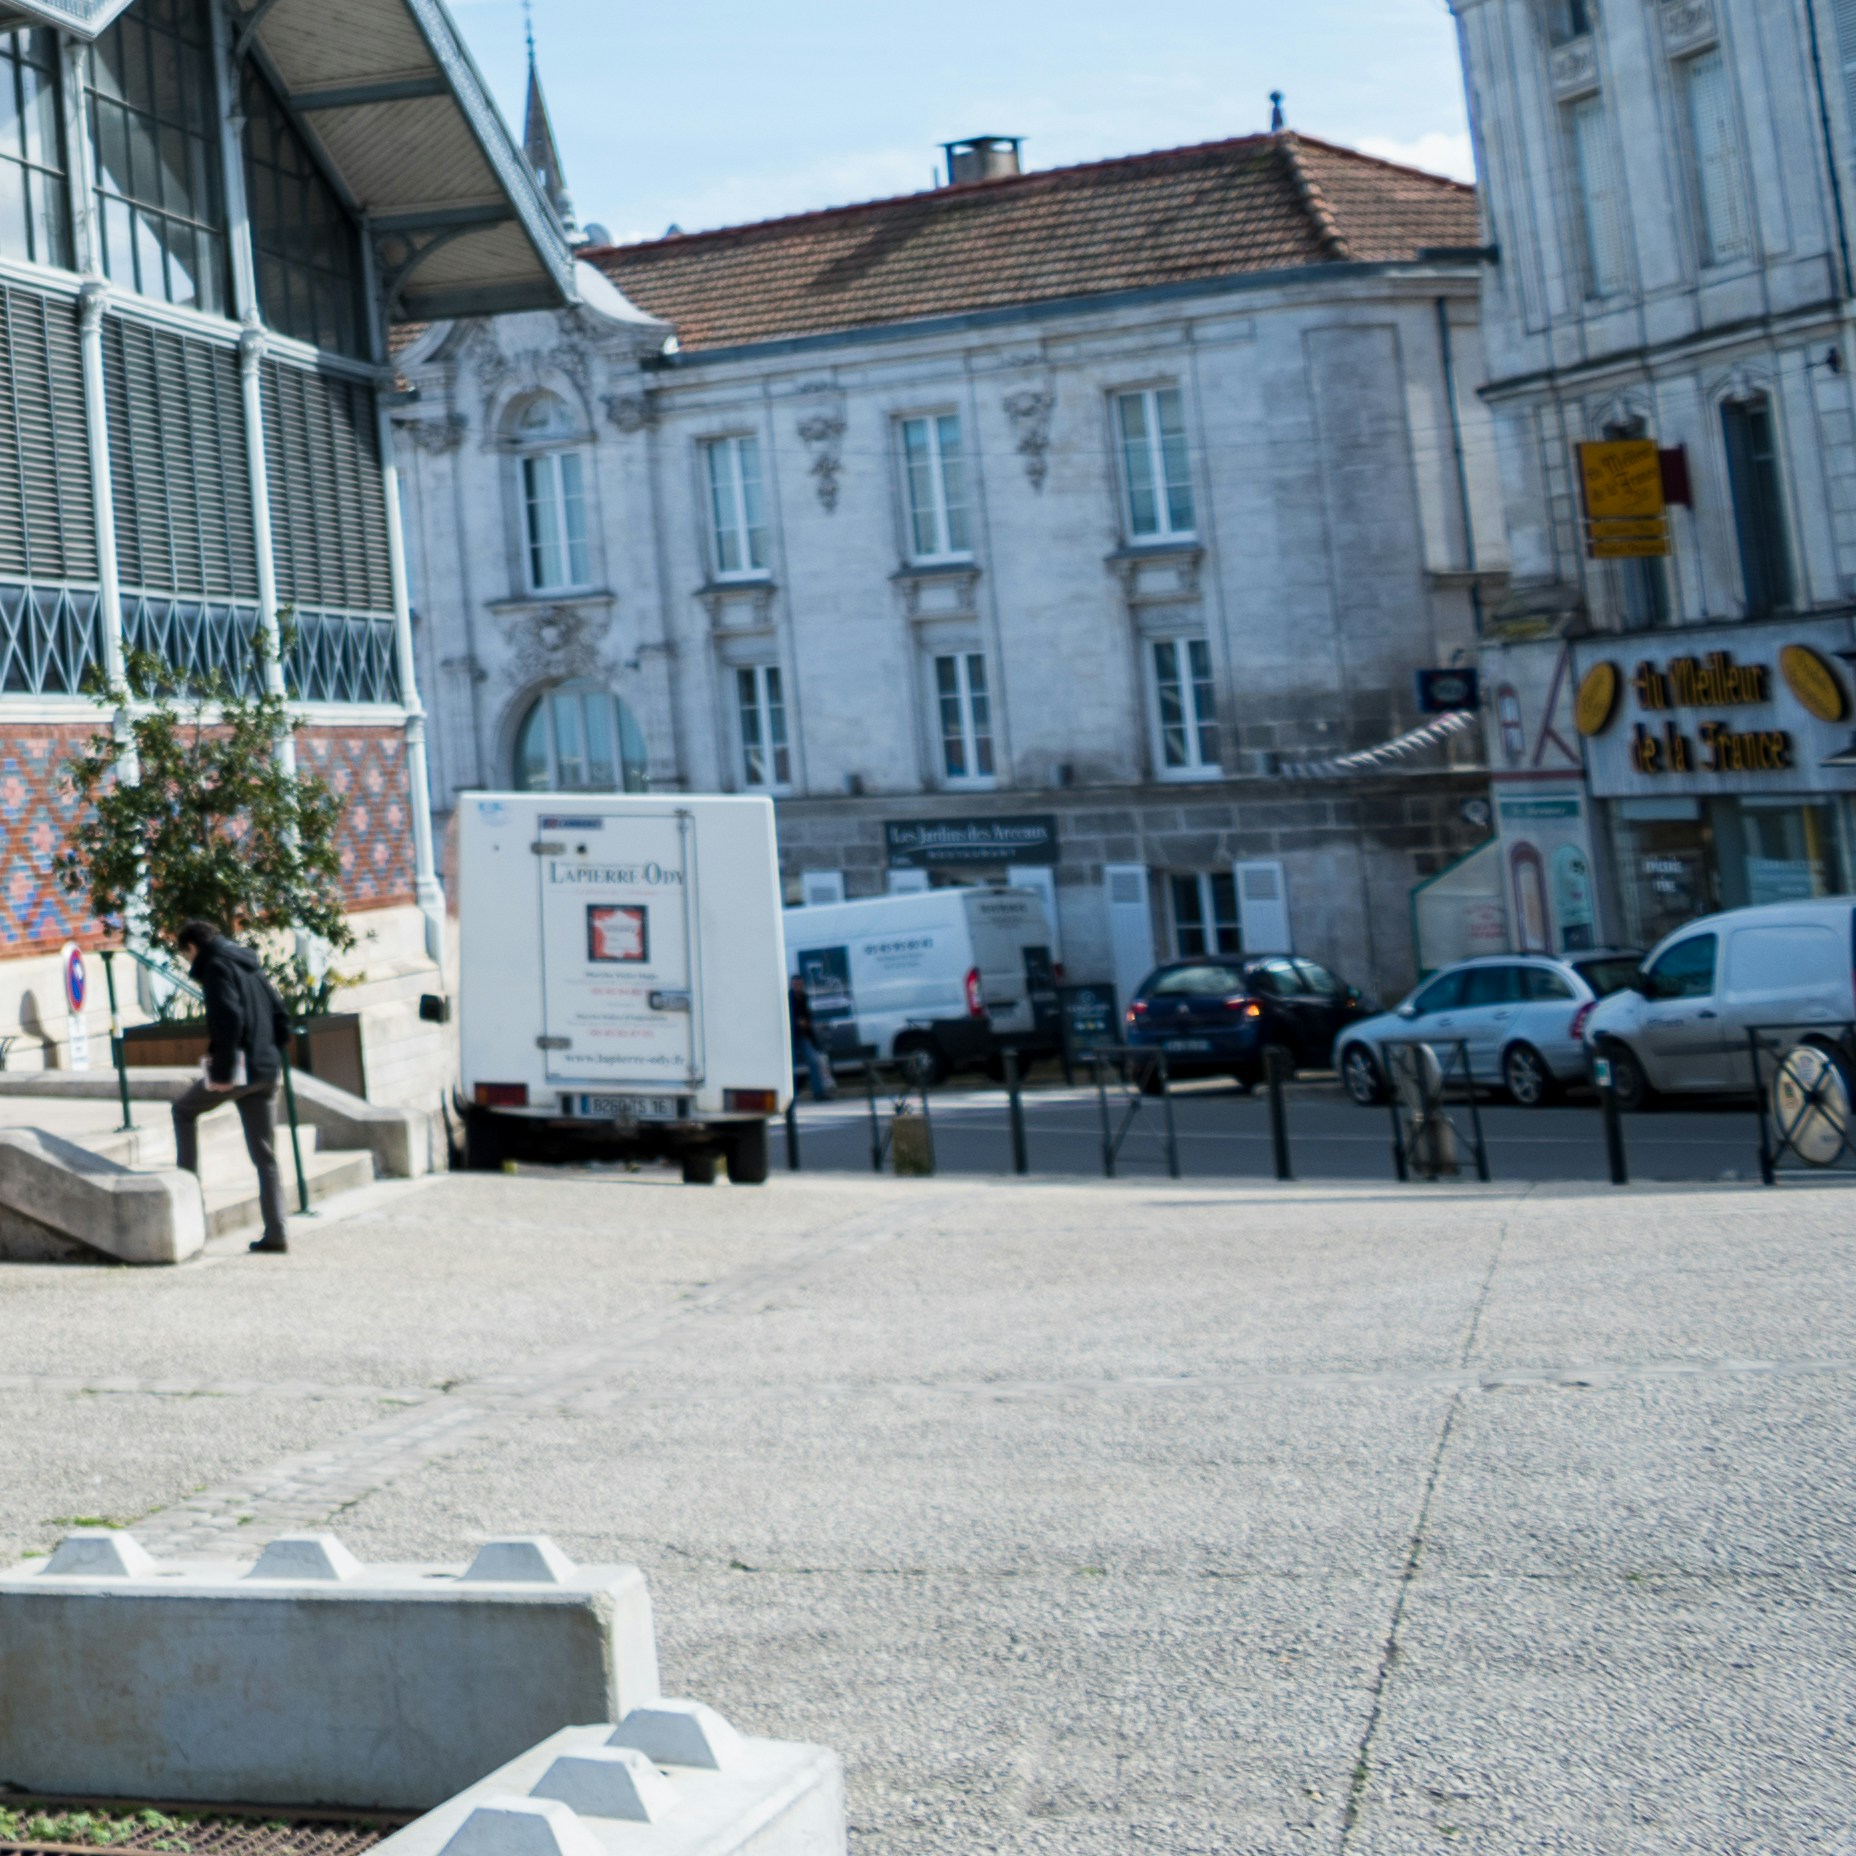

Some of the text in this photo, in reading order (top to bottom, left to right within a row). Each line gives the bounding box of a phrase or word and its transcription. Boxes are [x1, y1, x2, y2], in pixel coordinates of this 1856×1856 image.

[1669, 651, 1766, 705] Meilleur
[1630, 720, 1790, 774] de la France
[890, 821, 1049, 845] Les Jardins des Arceaux
